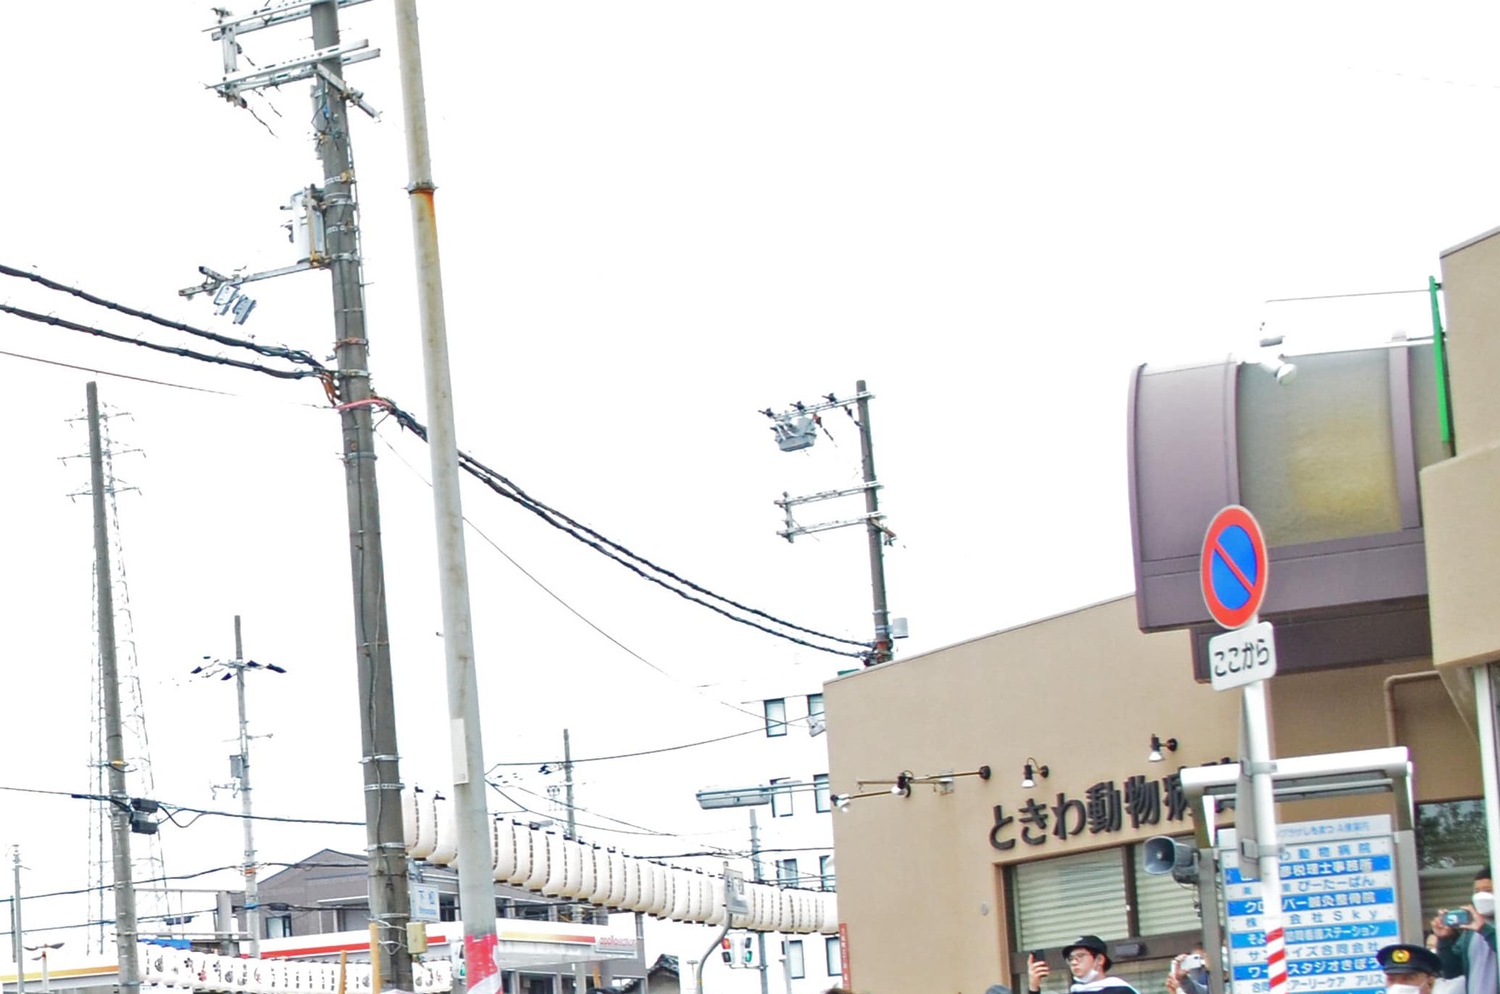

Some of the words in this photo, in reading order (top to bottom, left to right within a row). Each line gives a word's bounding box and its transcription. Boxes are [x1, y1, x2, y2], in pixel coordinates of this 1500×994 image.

[1213, 638, 1270, 678] ここから
[989, 759, 1239, 851] ときわ動物病
